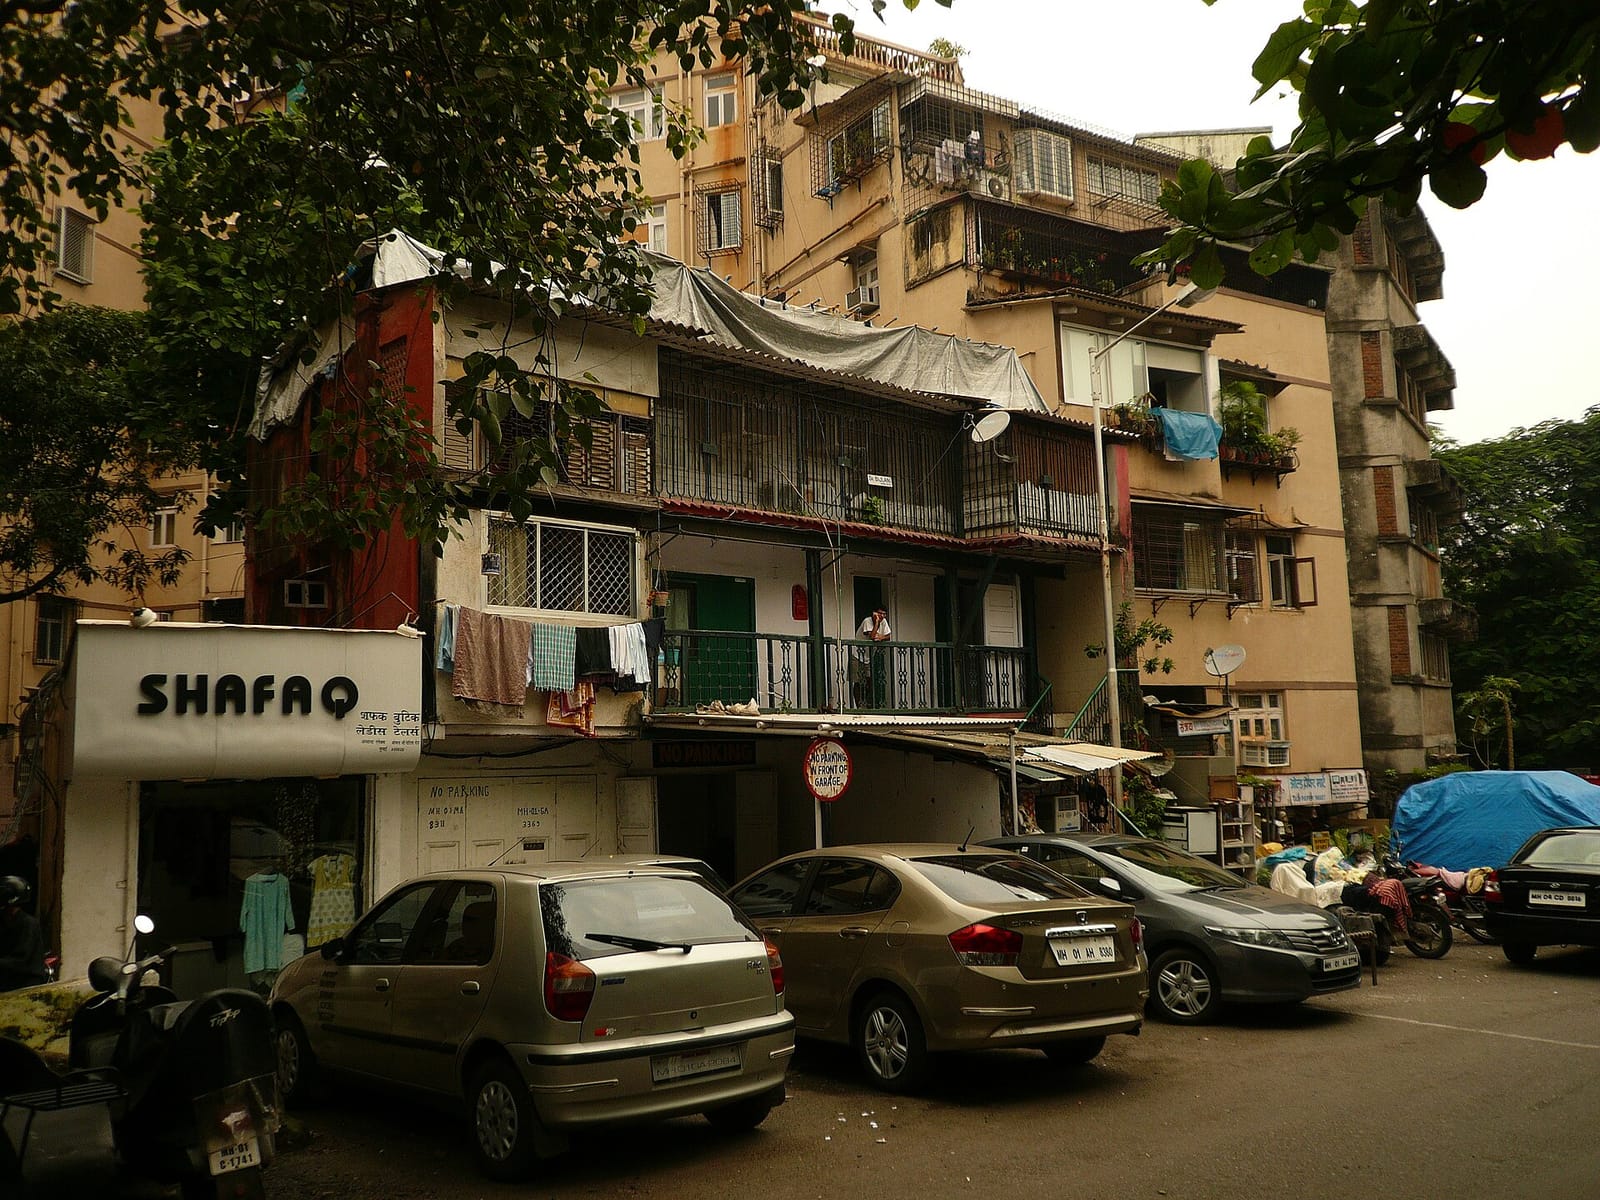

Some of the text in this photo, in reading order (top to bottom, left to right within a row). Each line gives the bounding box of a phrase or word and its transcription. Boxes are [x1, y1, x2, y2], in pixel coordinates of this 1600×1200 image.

[137, 674, 359, 719] SHAFAQ
[810, 753, 820, 763] NO
[818, 765, 838, 775] FRONT
[839, 764, 848, 774] OF
[815, 776, 841, 787] GARAGE
[430, 784, 490, 798] NO PARKING
[1056, 949, 1068, 960] MH
[1072, 948, 1081, 959] 01
